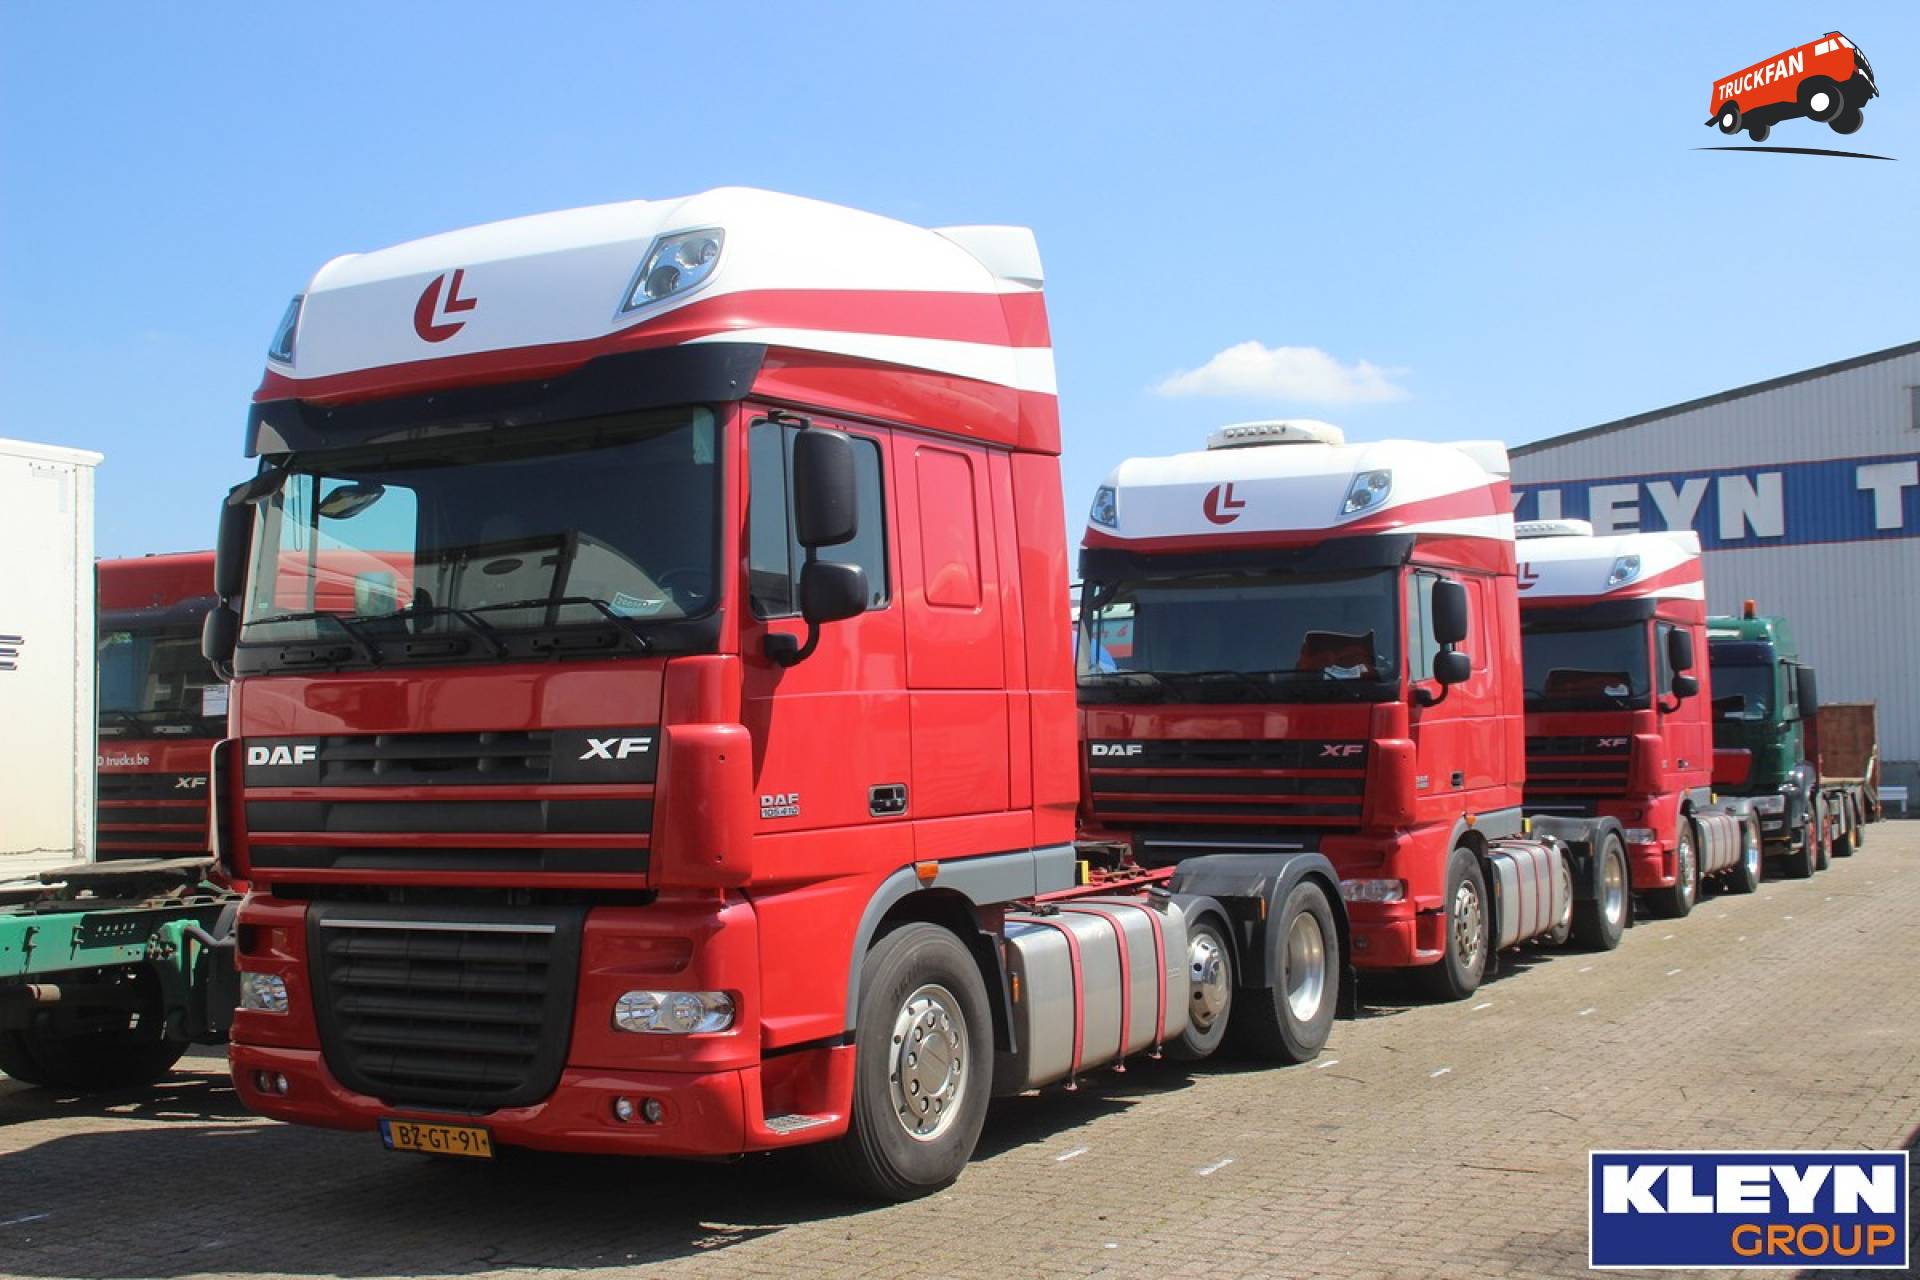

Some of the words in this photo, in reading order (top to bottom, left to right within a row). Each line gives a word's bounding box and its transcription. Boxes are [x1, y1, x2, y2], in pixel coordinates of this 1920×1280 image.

[1512, 472, 1784, 540] EYN
[579, 737, 652, 760] XF
[1597, 738, 1628, 747] XF
[247, 745, 317, 766] DAF
[1092, 743, 1143, 756] DAF
[1320, 744, 1364, 757] XF
[107, 753, 150, 766] trucks.be
[175, 777, 207, 788] XF
[761, 793, 799, 807] DAF
